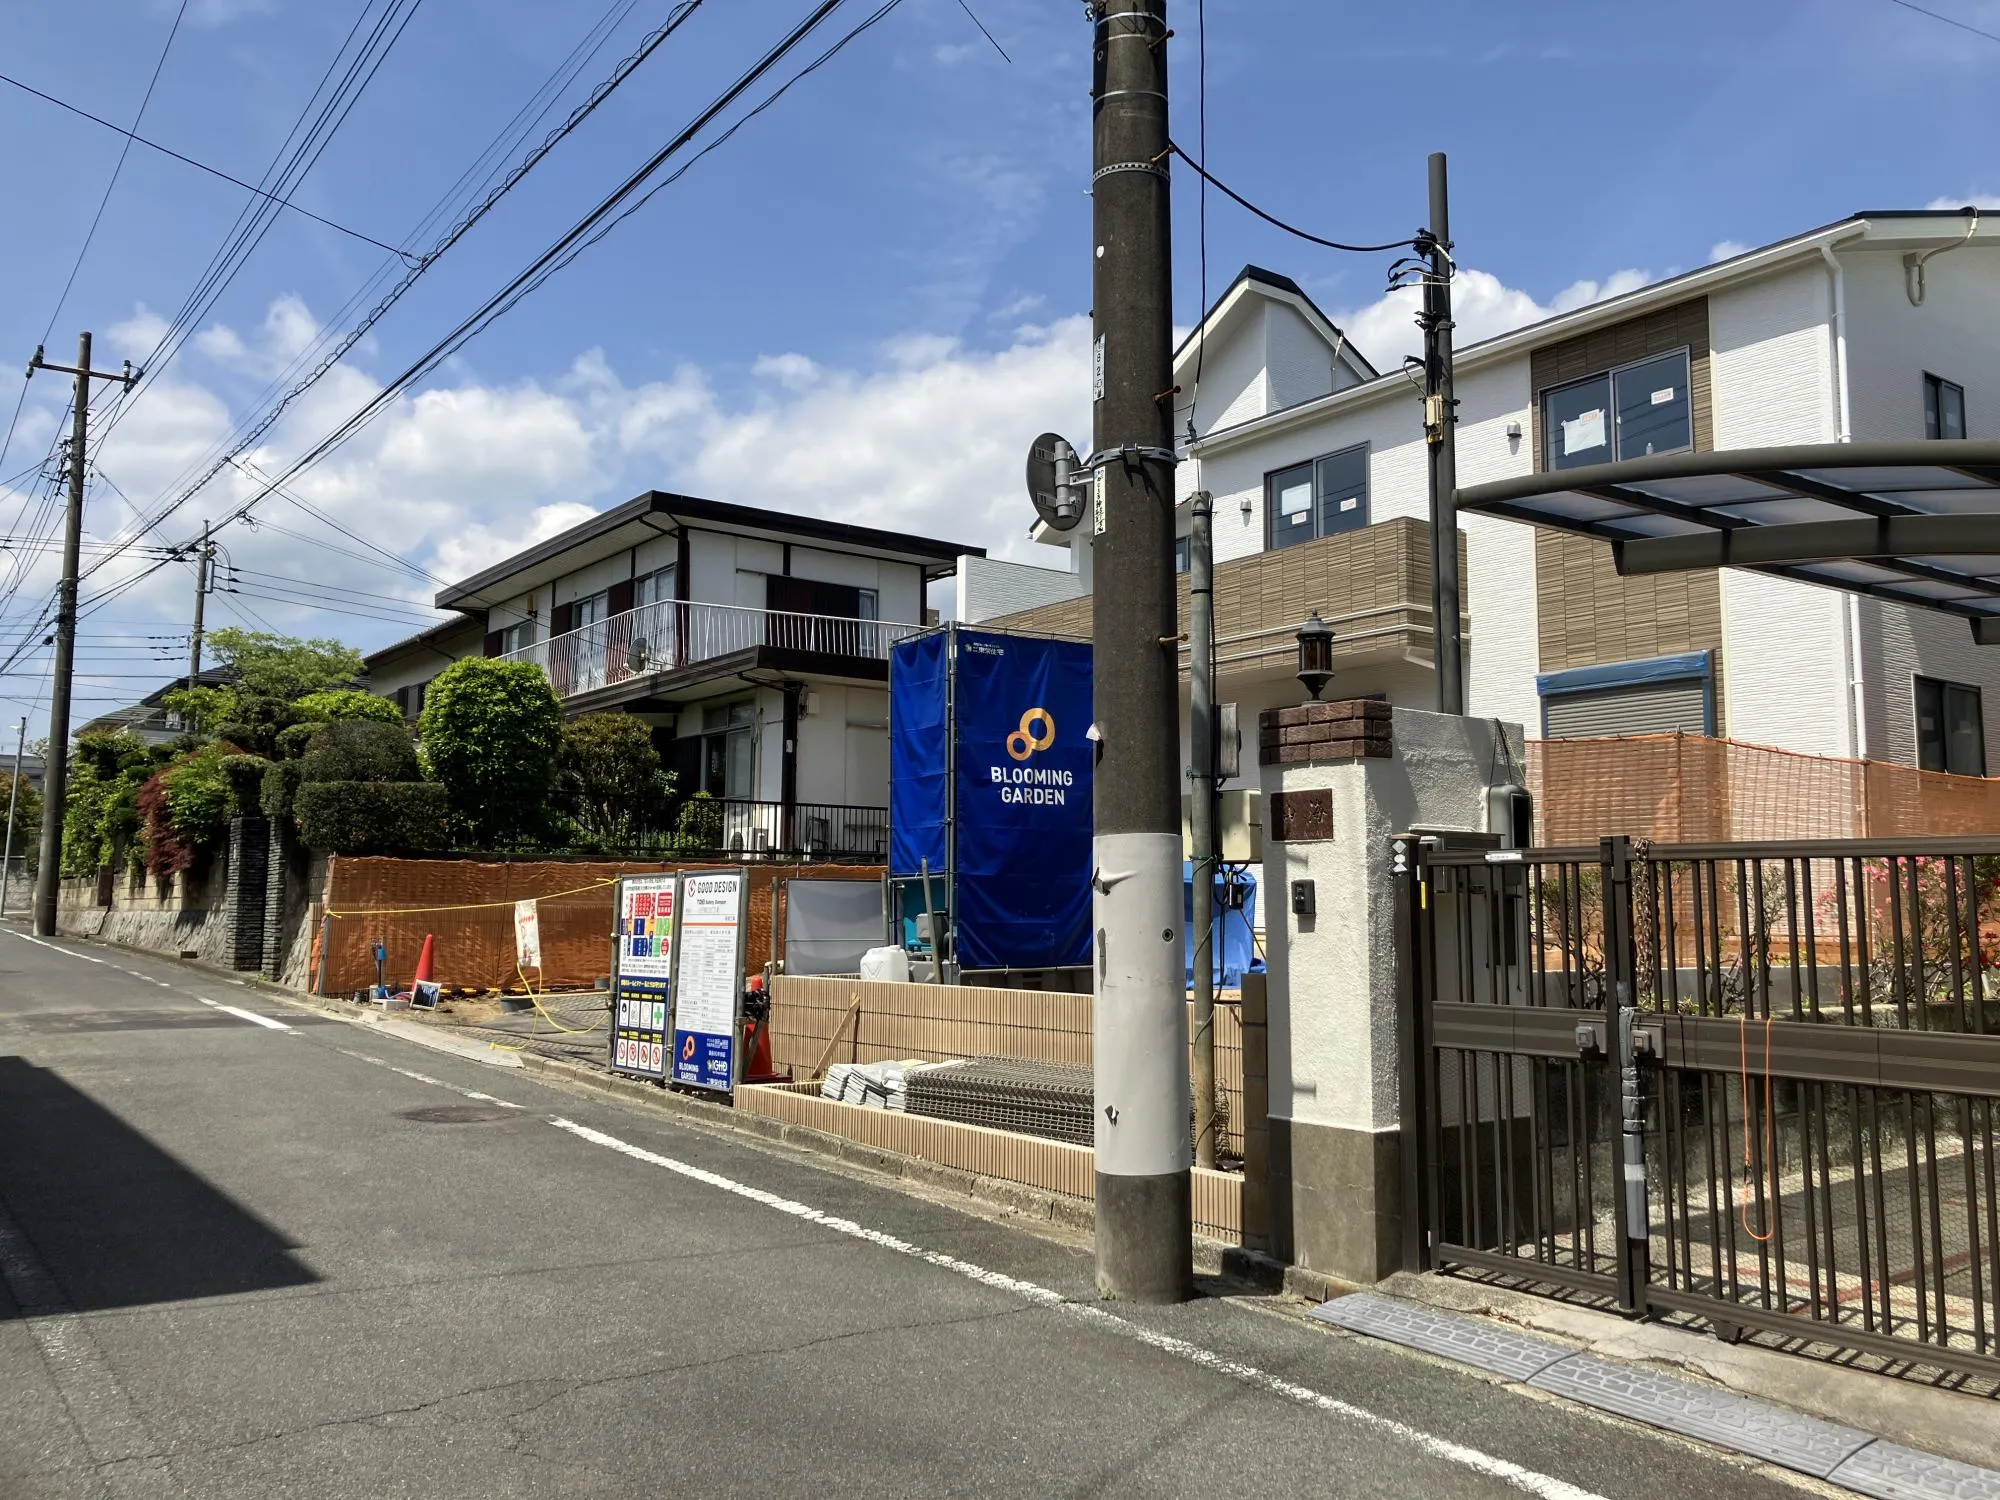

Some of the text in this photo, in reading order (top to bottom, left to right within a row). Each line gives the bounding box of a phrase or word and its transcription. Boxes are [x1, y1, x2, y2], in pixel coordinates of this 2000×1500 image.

[991, 766, 1073, 787] BLOOMING
[1001, 786, 1065, 806] GARDEN
[698, 881, 737, 893] GOOD DESIGN
[679, 1062, 699, 1072] BLOOMING
[681, 1072, 696, 1081] GARDEN
